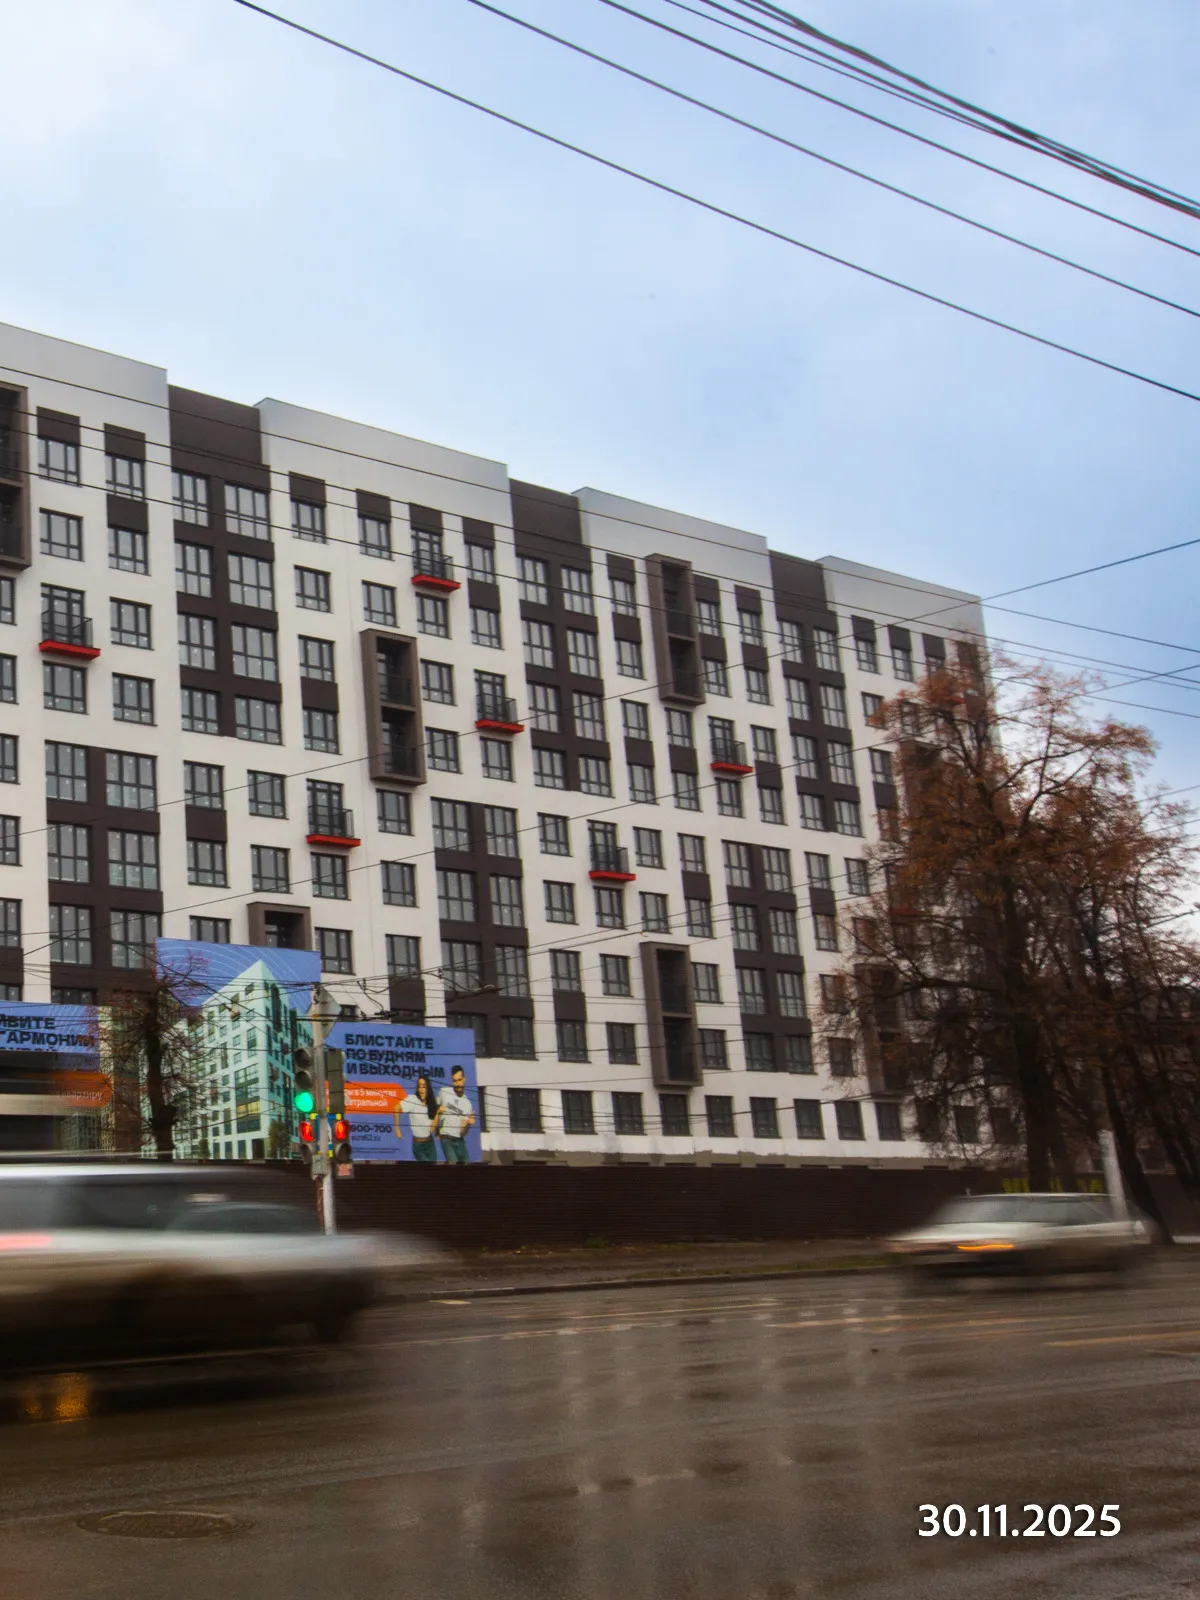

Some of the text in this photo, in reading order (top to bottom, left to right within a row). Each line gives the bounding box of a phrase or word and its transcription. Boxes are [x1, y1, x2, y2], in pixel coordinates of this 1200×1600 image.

[344, 1033, 434, 1050] БЛИСТАЙТЕ
[346, 1048, 426, 1064] ПО БУДНЯМ
[347, 1063, 445, 1078] И ВЫХОДНЫМ
